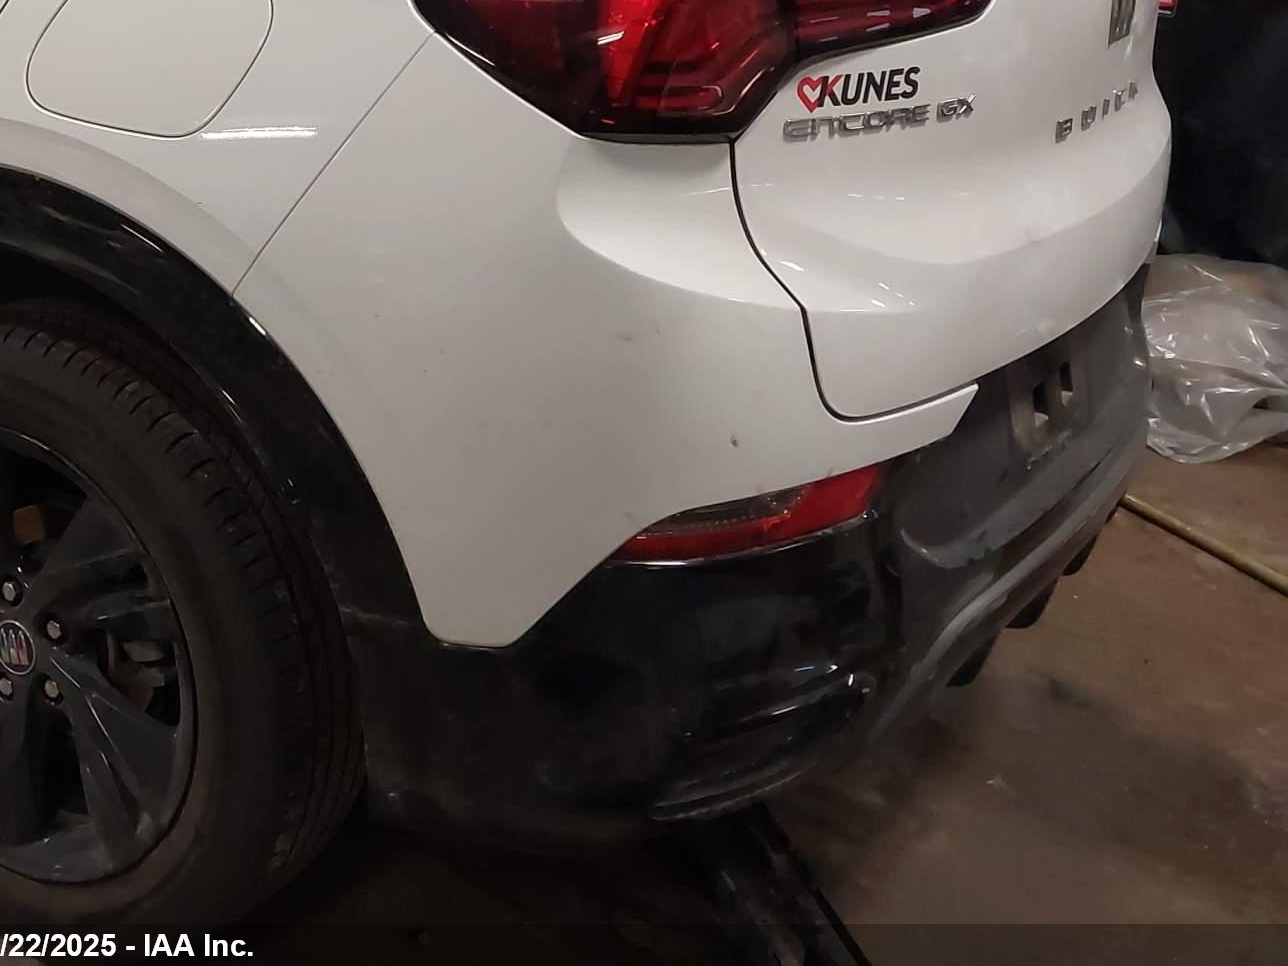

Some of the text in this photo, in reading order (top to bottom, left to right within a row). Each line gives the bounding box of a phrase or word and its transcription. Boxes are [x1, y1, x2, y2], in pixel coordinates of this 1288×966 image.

[816, 66, 921, 108] KUNES
[783, 94, 976, 140] ENCORE GX
